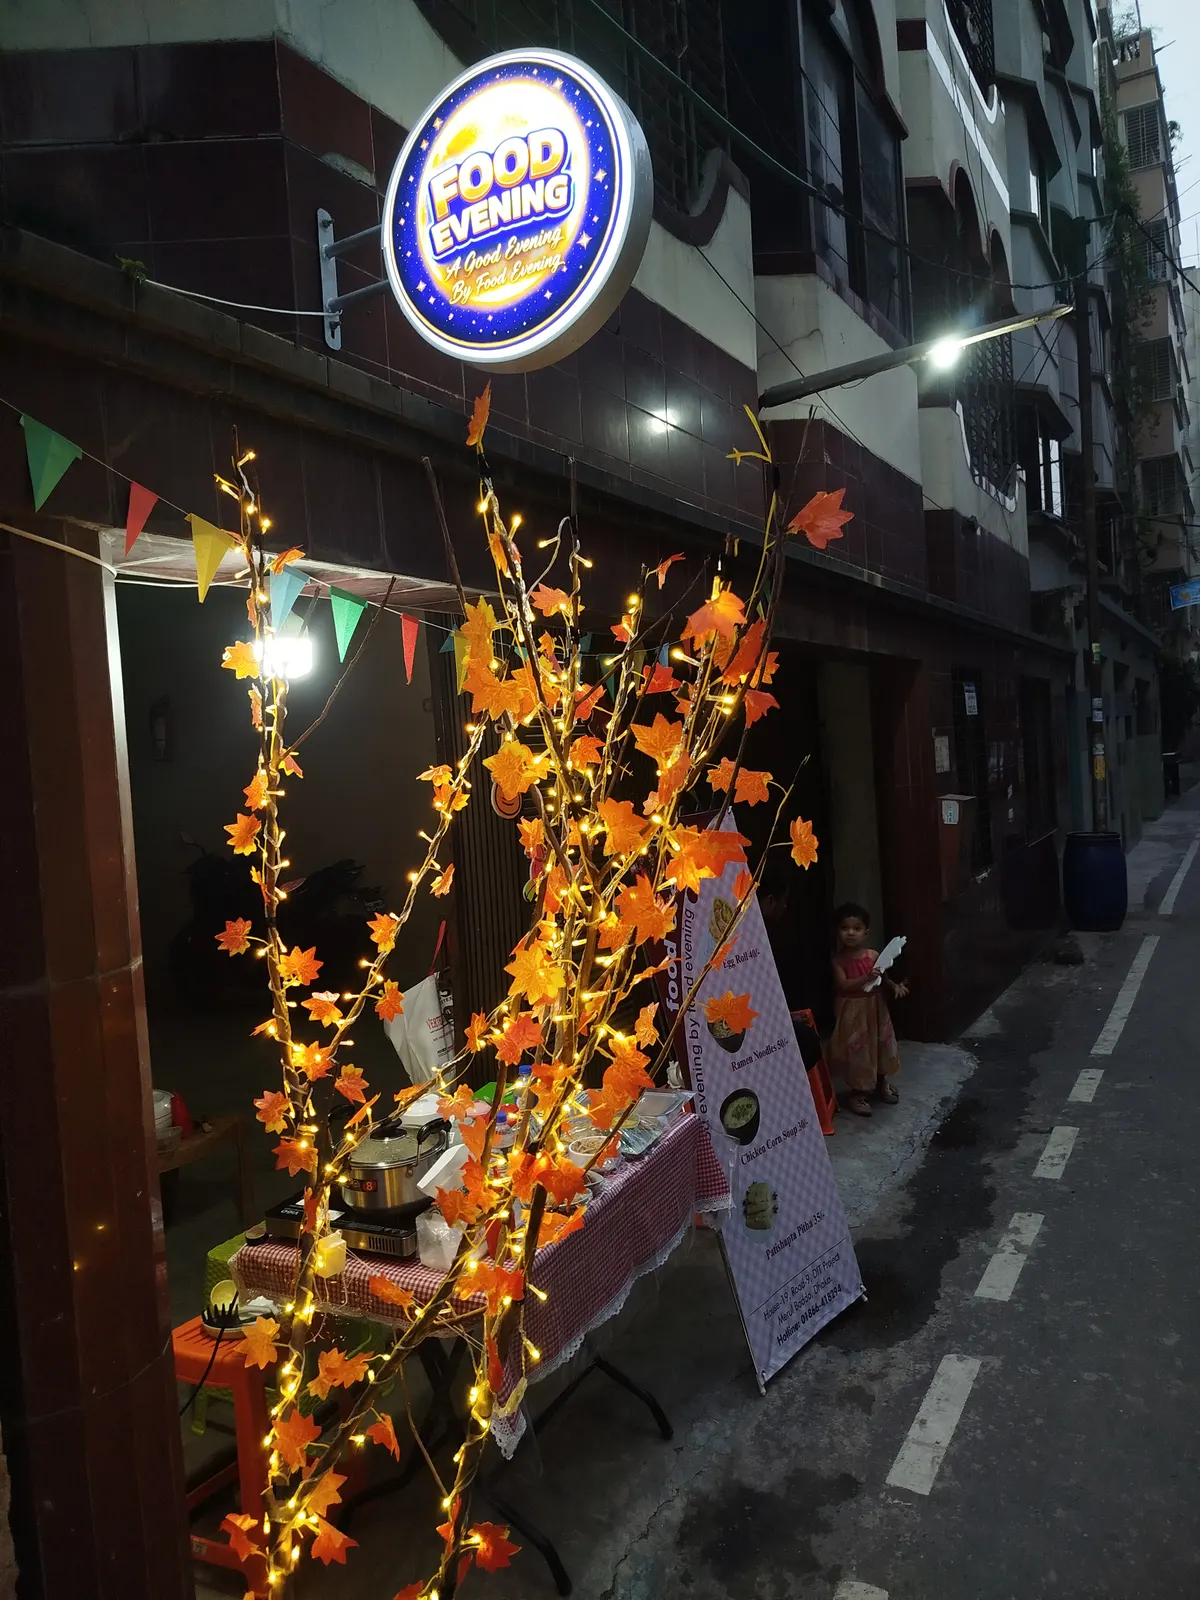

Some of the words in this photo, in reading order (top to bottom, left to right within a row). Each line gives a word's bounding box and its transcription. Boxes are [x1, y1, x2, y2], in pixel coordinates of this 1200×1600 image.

[430, 129, 566, 220] FOOD
[431, 176, 569, 254] EVENING
[445, 262, 461, 280] A
[465, 248, 501, 277] Good
[507, 228, 565, 256] Evening
[450, 280, 472, 305] By
[476, 268, 507, 295] Food
[509, 254, 565, 283] Evening
[683, 908, 695, 972] evening
[722, 957, 736, 969] Egg
[735, 951, 748, 964] Roll
[664, 939, 680, 1012] food
[689, 1019, 700, 1039] by
[731, 1054, 754, 1072] Ramen
[753, 1046, 777, 1062] Noodles
[692, 1045, 707, 1114] evening
[741, 1144, 767, 1166] Chicken
[766, 1134, 782, 1151] Corn
[782, 1126, 798, 1141] Soup
[366, 1181, 373, 1191] 8
[765, 1231, 798, 1261] Patishapta
[796, 1220, 814, 1237] Pitha
[822, 1252, 841, 1270] Project
[812, 1276, 832, 1295] Dhaka
[776, 1321, 801, 1346] Hotline:
